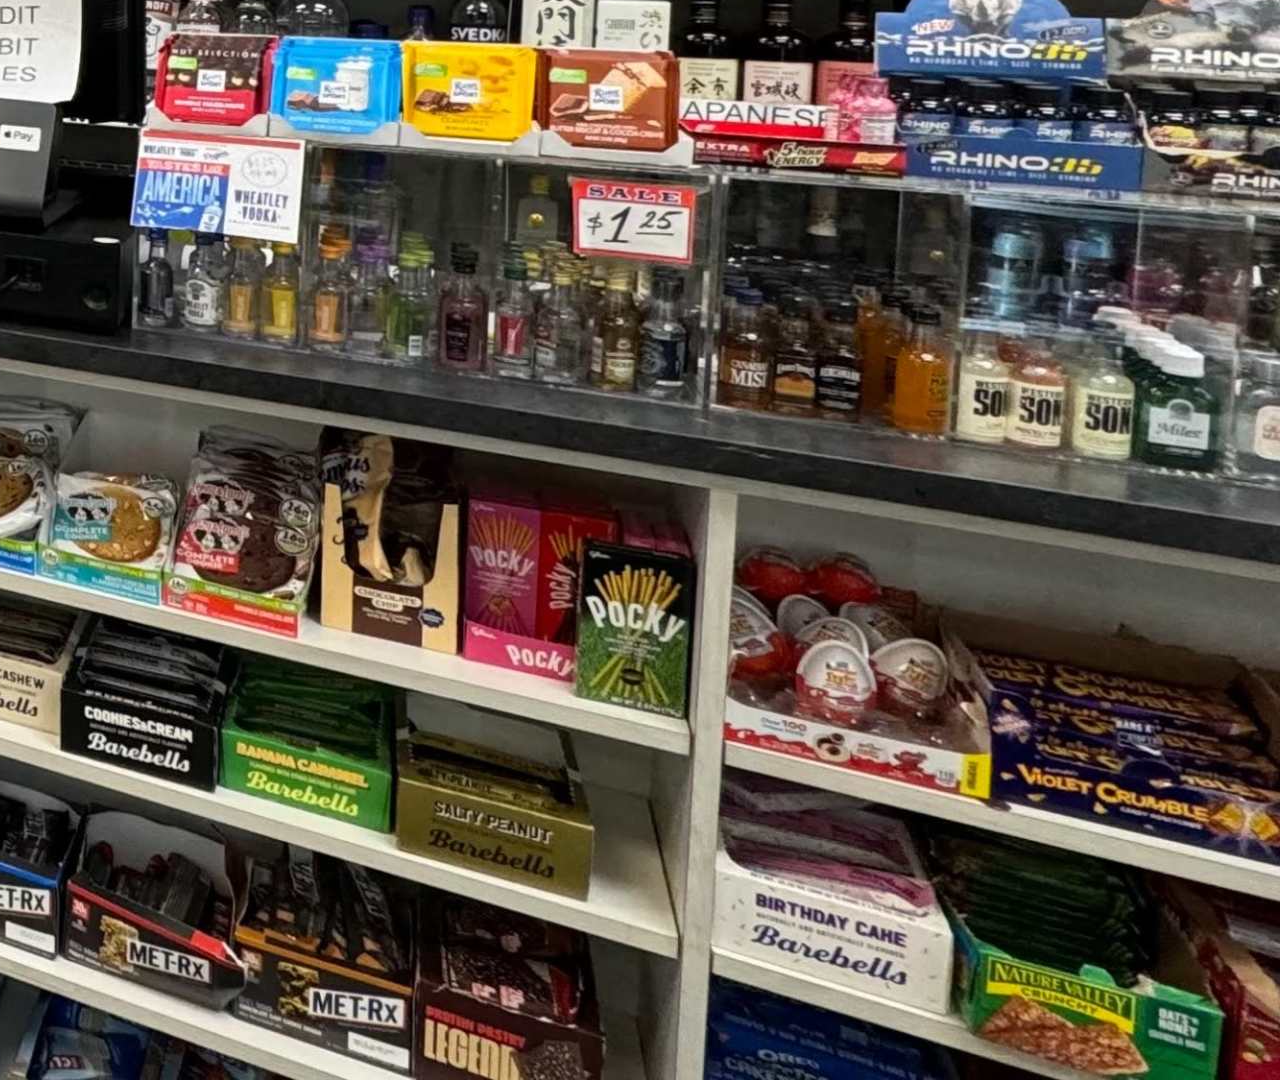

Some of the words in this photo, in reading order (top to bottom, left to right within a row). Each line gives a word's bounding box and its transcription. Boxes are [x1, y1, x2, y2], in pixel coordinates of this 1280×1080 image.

[915, 20, 955, 35] NEW
[197, 49, 260, 59] SELECTION
[905, 39, 1032, 60] RHINO
[682, 100, 836, 129] APANESE
[902, 119, 951, 130] RHINO
[12, 130, 35, 143] Pay
[696, 141, 751, 155] EXTRA
[780, 142, 828, 158] 5-hour
[774, 153, 825, 168] ENERGY
[930, 151, 1050, 172] RHINO
[142, 171, 220, 207] AMERICA
[234, 189, 289, 209] WHEATLEY
[586, 183, 682, 205] SALE
[241, 206, 278, 223] VODKA
[1084, 403, 1132, 436] SON
[54, 524, 109, 537] COMPLETE
[176, 549, 235, 566] COMPLETE
[354, 586, 420, 607] CHOCOLATE
[87, 732, 191, 773] Barebells
[235, 741, 297, 771] BANANA
[297, 757, 369, 789] CARAMEL
[246, 770, 359, 817] Barebells
[1016, 763, 1094, 796] VIOLET
[1095, 781, 1210, 821] CRUMBLE
[434, 800, 485, 825] SALTY
[487, 813, 555, 845] PEANUT
[428, 828, 556, 879] Barebells
[754, 893, 848, 931] BIRTHDAY
[854, 921, 908, 948] CAKE
[749, 922, 908, 986] Barebells
[993, 961, 1064, 994] NATURE
[1064, 978, 1131, 1012] VALLEY
[1020, 987, 1098, 1017] CRUNCHY
[478, 1024, 527, 1049] PASTRY
